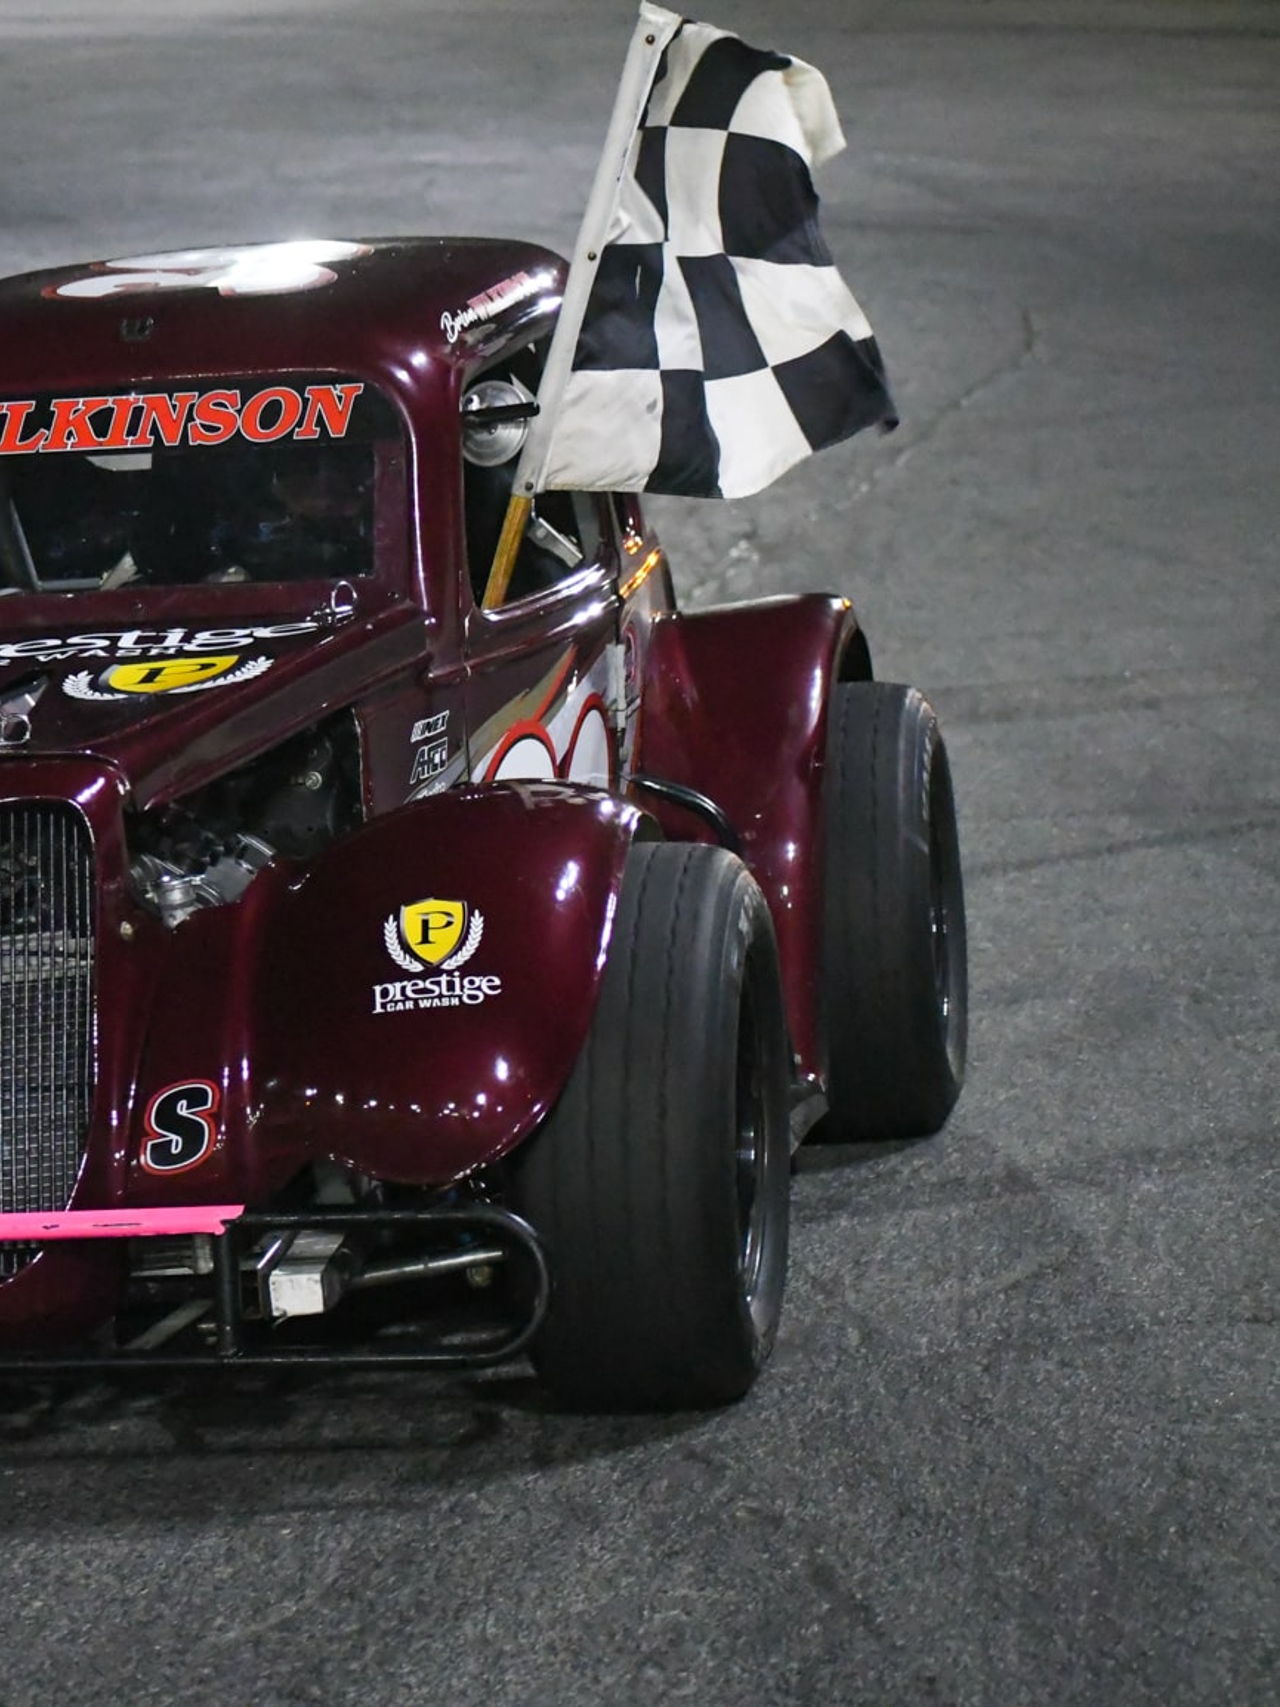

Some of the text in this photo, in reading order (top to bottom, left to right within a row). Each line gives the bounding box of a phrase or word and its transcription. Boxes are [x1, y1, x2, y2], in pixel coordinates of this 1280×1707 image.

[128, 662, 218, 685] P
[414, 910, 455, 946] P
[372, 971, 502, 1014] prestige
[386, 996, 460, 1012] CAR WASH
[140, 1079, 220, 1175] S
